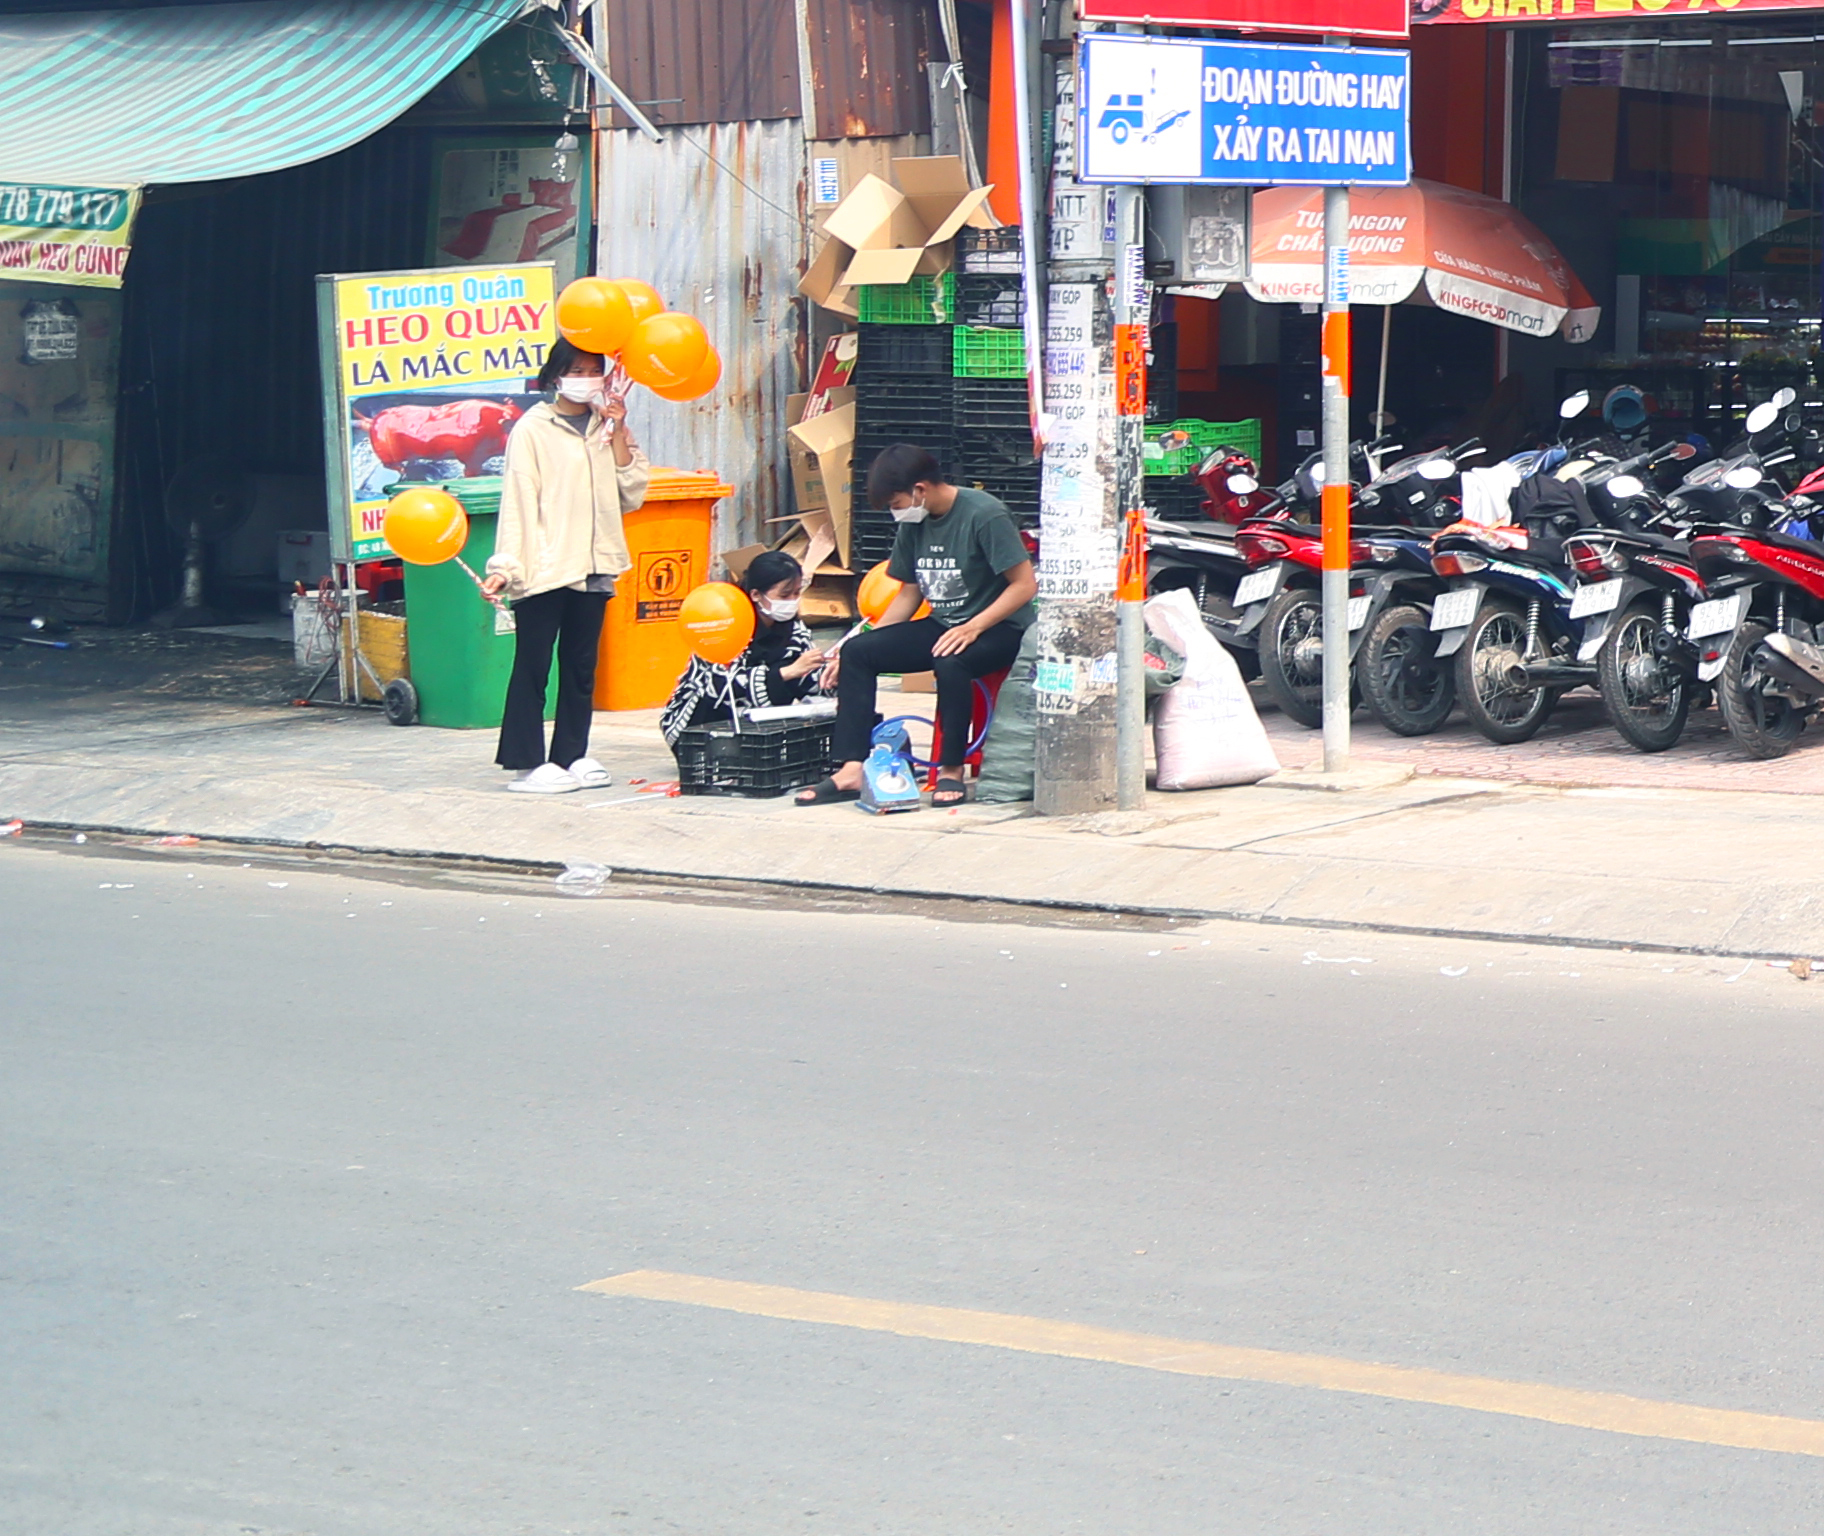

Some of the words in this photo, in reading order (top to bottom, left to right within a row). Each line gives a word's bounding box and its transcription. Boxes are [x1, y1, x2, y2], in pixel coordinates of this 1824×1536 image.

[1202, 66, 1274, 112] ĐOẠN
[1276, 61, 1358, 109] ĐƯỜNG
[1361, 75, 1405, 110] HAY
[1213, 115, 1263, 162] XẢY
[1267, 130, 1302, 163] RA
[1306, 131, 1342, 163] TAI
[1346, 131, 1395, 173] NẠN
[1347, 215, 1407, 231] NGON
[38, 242, 72, 272] HEO
[463, 275, 524, 303] Quân
[346, 314, 429, 348] HEO
[445, 303, 548, 339] QUAY
[352, 351, 391, 386] LÁ
[402, 342, 472, 381] MẮC
[483, 339, 547, 375] MẬT
